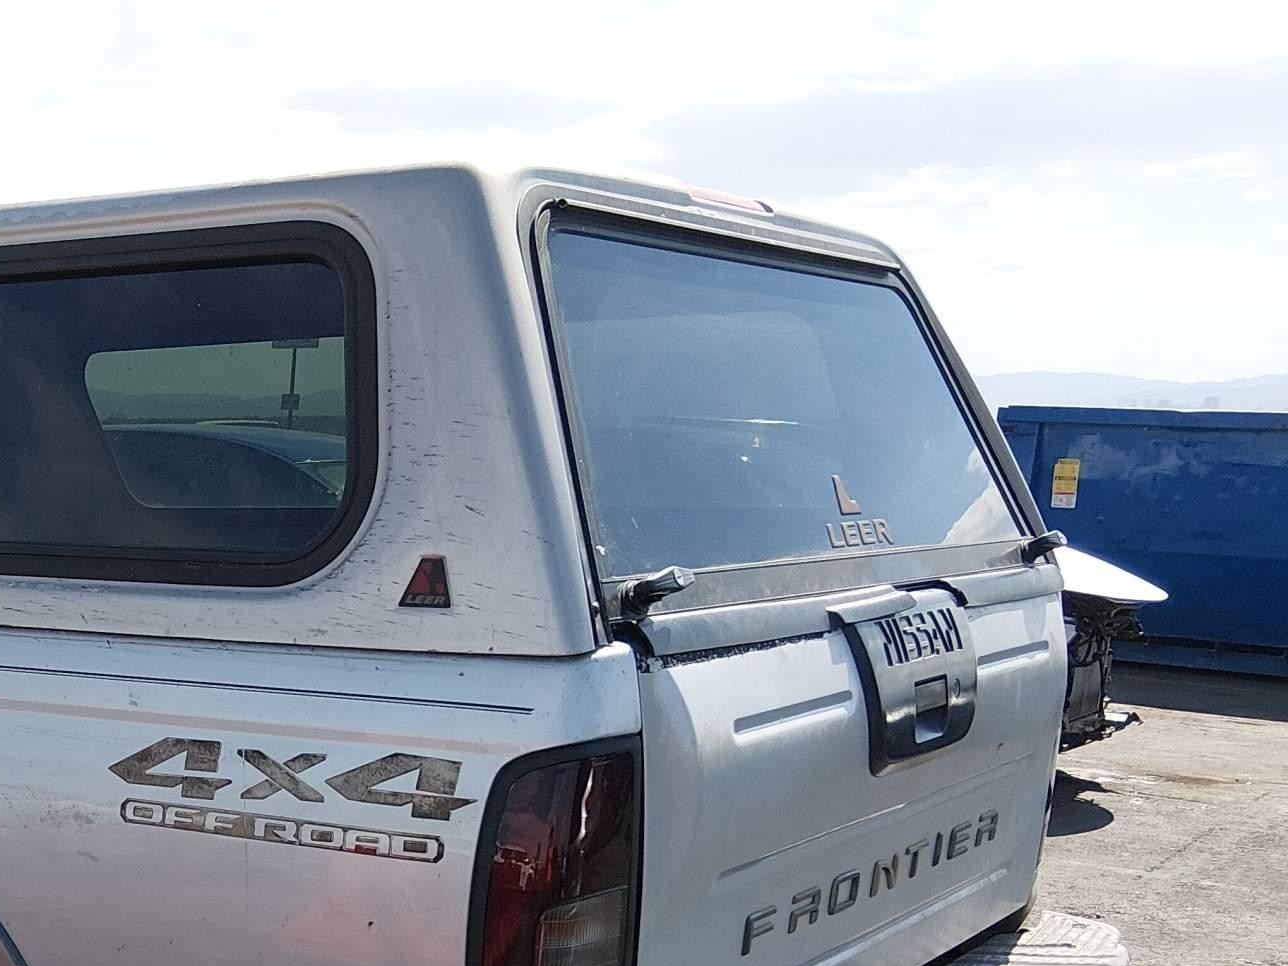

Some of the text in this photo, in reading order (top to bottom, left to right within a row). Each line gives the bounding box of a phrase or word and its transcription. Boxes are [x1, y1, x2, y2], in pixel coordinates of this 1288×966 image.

[825, 518, 895, 549] LEER
[404, 593, 447, 605] LEER
[874, 606, 966, 668] NISSAN
[740, 807, 1001, 957] FRONTIER
